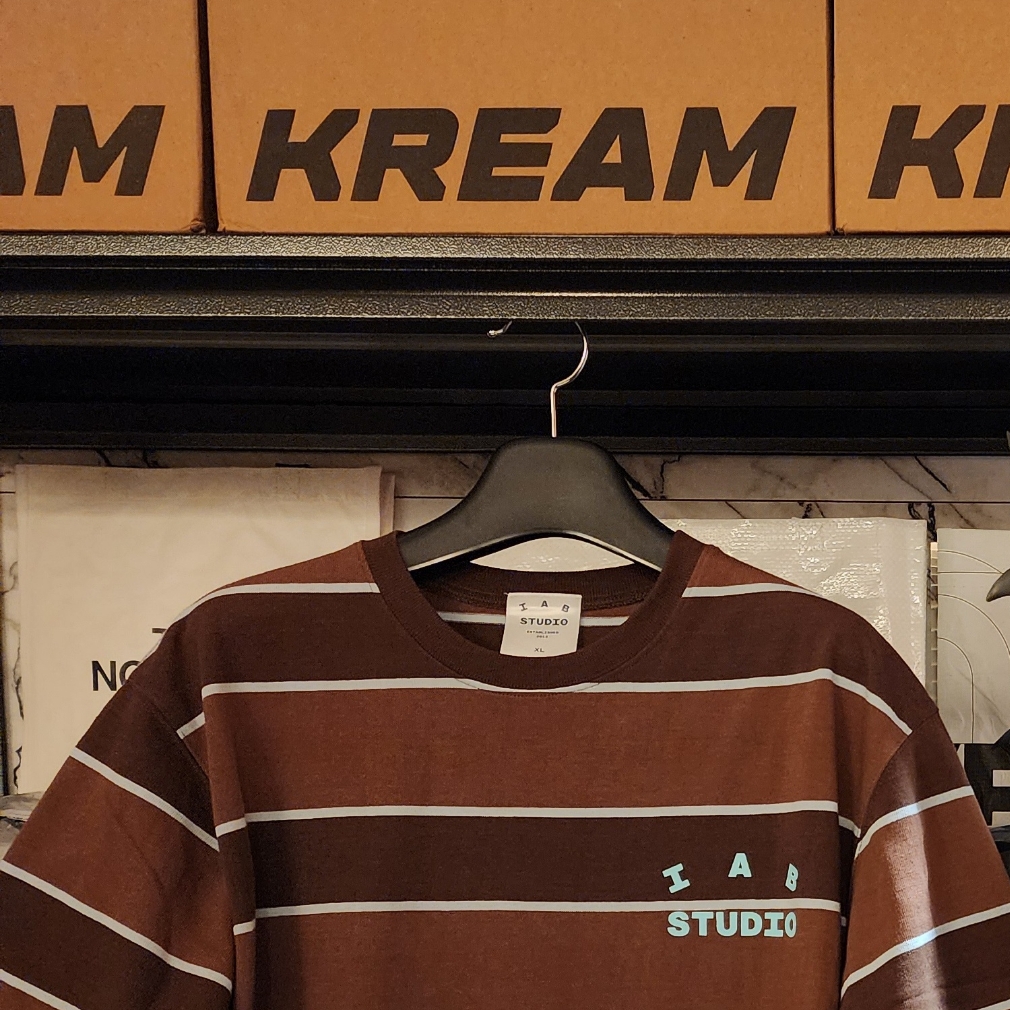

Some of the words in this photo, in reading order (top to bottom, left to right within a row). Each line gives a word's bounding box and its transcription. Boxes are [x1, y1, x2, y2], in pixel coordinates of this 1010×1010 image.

[0, 105, 166, 196] M
[246, 106, 797, 202] KREAM
[520, 617, 568, 625] STUDIO
[667, 911, 797, 938] STUDIO
